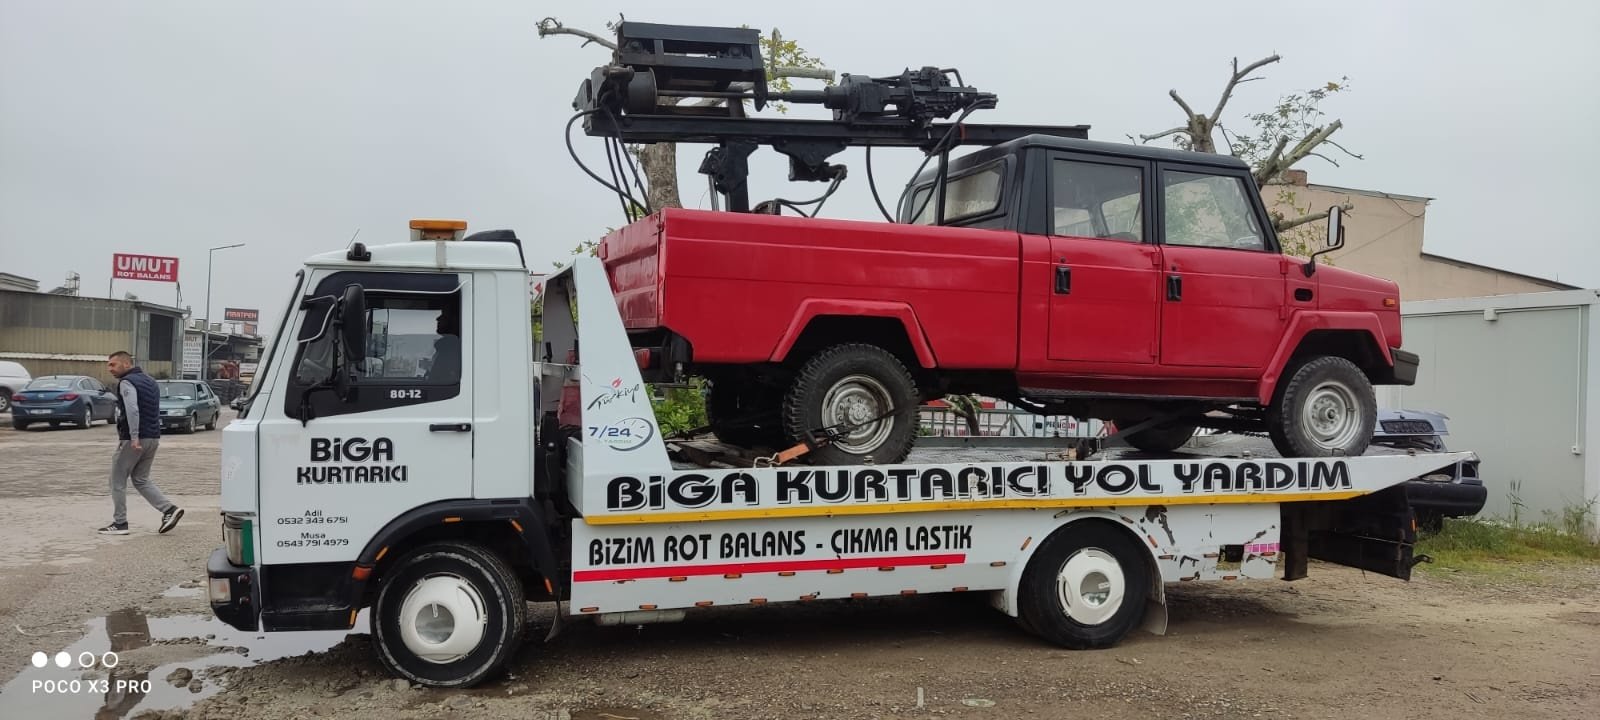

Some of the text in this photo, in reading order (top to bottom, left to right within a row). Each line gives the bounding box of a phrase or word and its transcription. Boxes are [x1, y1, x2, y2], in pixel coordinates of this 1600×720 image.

[117, 255, 175, 274] UMUT
[390, 389, 422, 399] 80-12
[588, 425, 632, 439] 7/24
[296, 465, 408, 485] KURTARICI
[776, 465, 1050, 504] KURTARICI
[1064, 463, 1164, 495] YOL
[1172, 460, 1353, 493] YARDIM
[277, 517, 304, 525] 0532
[326, 516, 348, 524] 6751
[277, 538, 349, 548] 0543 791 4979
[663, 534, 712, 562] ROT
[719, 529, 806, 559] BALANS
